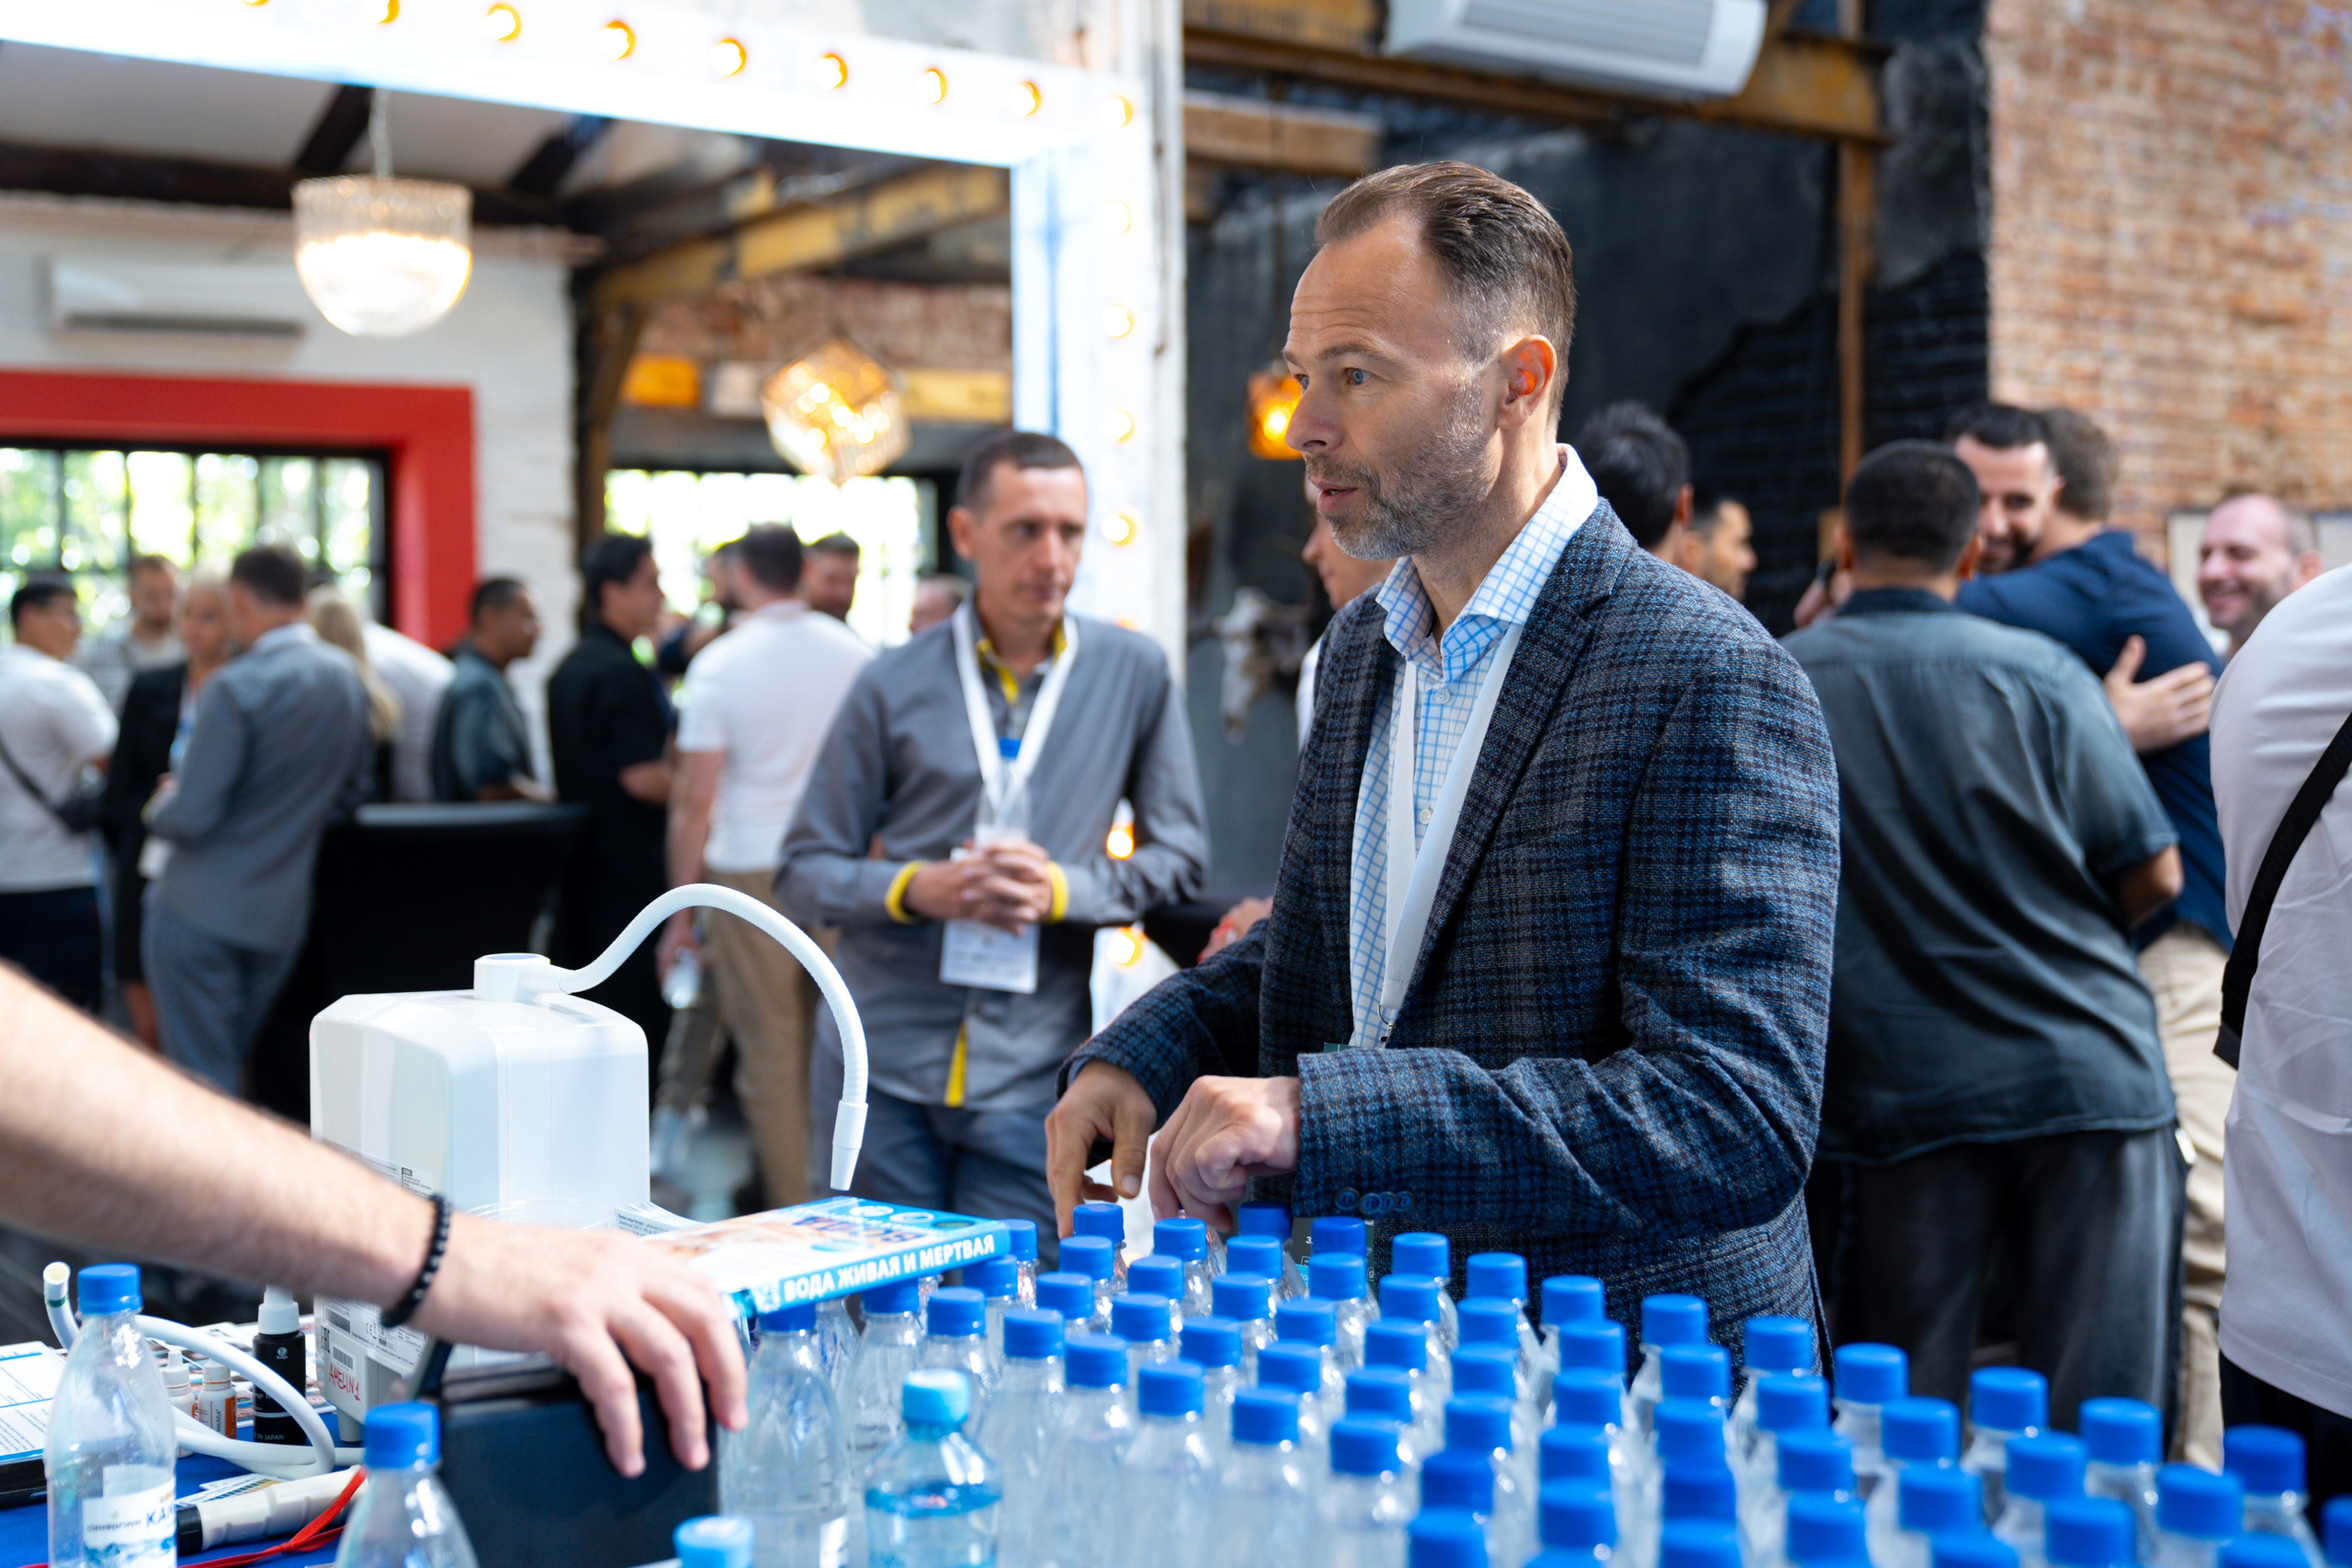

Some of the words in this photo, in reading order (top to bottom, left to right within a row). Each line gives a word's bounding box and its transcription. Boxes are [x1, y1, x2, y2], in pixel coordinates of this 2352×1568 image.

[784, 1277, 835, 1303] ВОДА
[837, 1258, 900, 1288] ЖИВАЯ
[903, 1255, 917, 1273] И
[920, 1235, 996, 1269] МЕРТВАЯ
